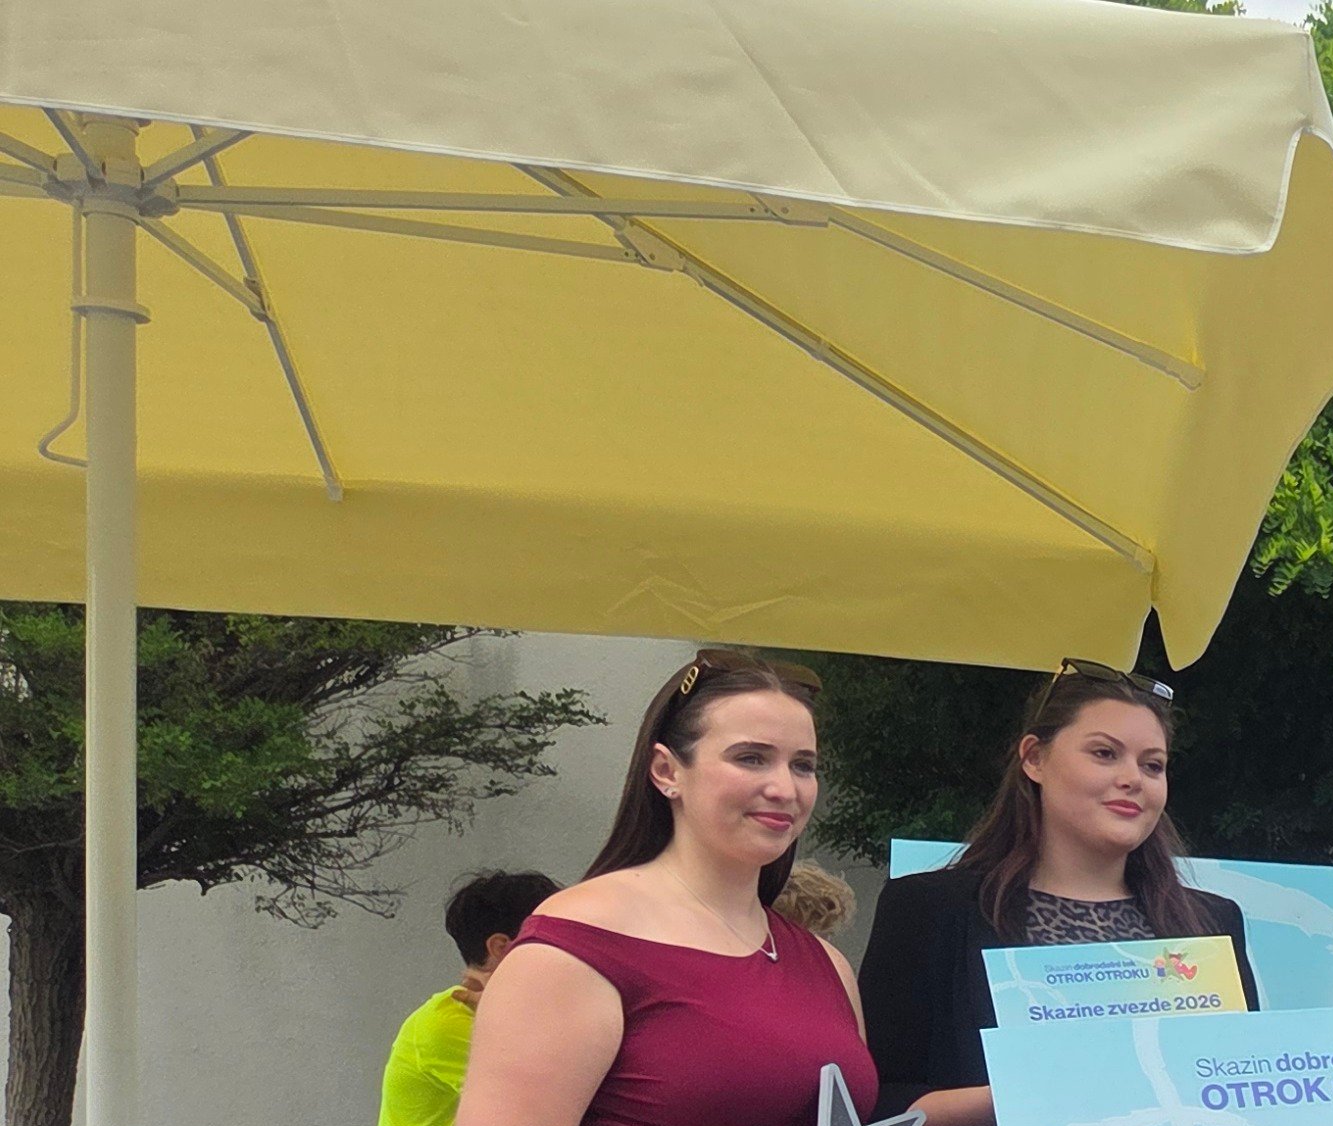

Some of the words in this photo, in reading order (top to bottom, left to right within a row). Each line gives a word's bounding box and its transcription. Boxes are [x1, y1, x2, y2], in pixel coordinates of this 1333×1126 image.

[1046, 971, 1095, 985] OTROK
[1095, 968, 1150, 982] OTROKU
[1029, 1005, 1104, 1022] Skazine
[1108, 998, 1171, 1016] zvezde
[1174, 993, 1221, 1011] 2026
[1196, 1057, 1272, 1078] Skazin
[1202, 1077, 1331, 1111] OTROK
